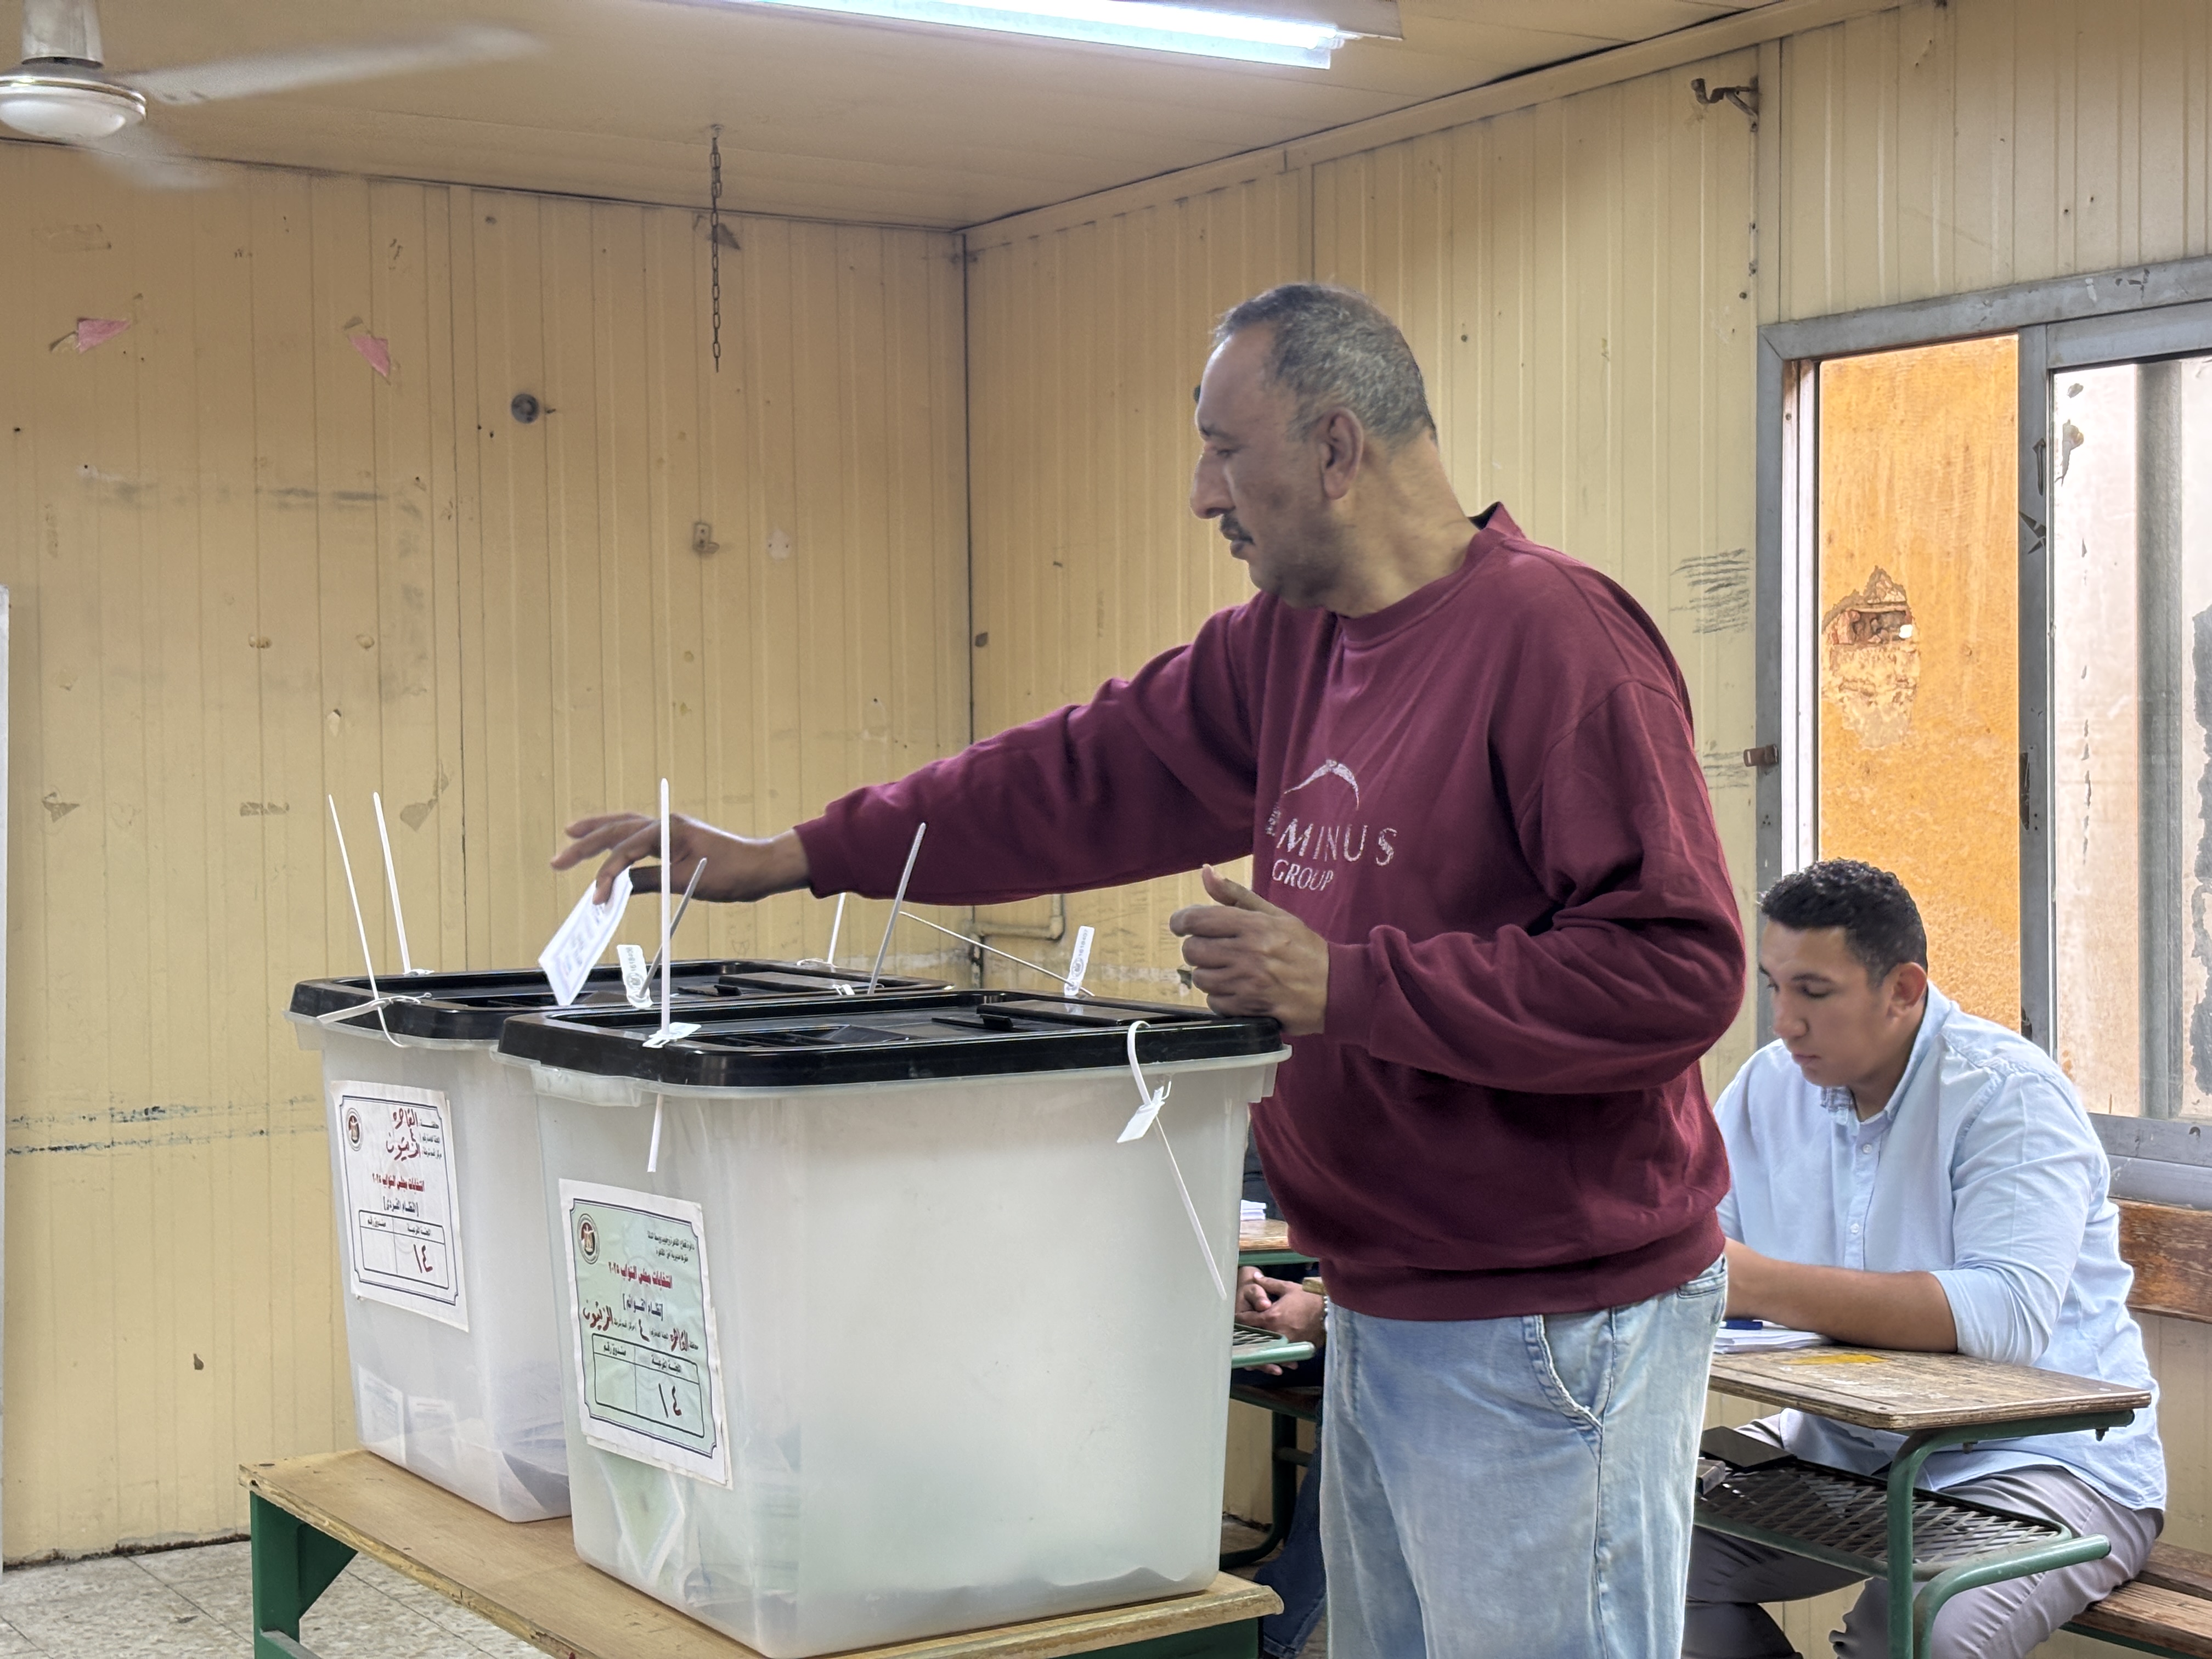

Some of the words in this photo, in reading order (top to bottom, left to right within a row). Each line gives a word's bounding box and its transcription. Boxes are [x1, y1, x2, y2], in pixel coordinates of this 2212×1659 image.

[1272, 859, 1334, 891] GROUP
[382, 1174, 396, 1189] النواب
[397, 1176, 408, 1193] مجلس
[408, 1177, 425, 1195] انتخابات
[413, 1243, 433, 1274] ١٤
[620, 1263, 637, 1282] النواب
[639, 1268, 651, 1286] مجلس
[652, 1270, 673, 1291] انتخابات
[583, 1299, 614, 1331] الزيتون
[603, 1341, 613, 1355] رقم
[612, 1343, 627, 1356] صندوق
[658, 1383, 682, 1419] ١٤
